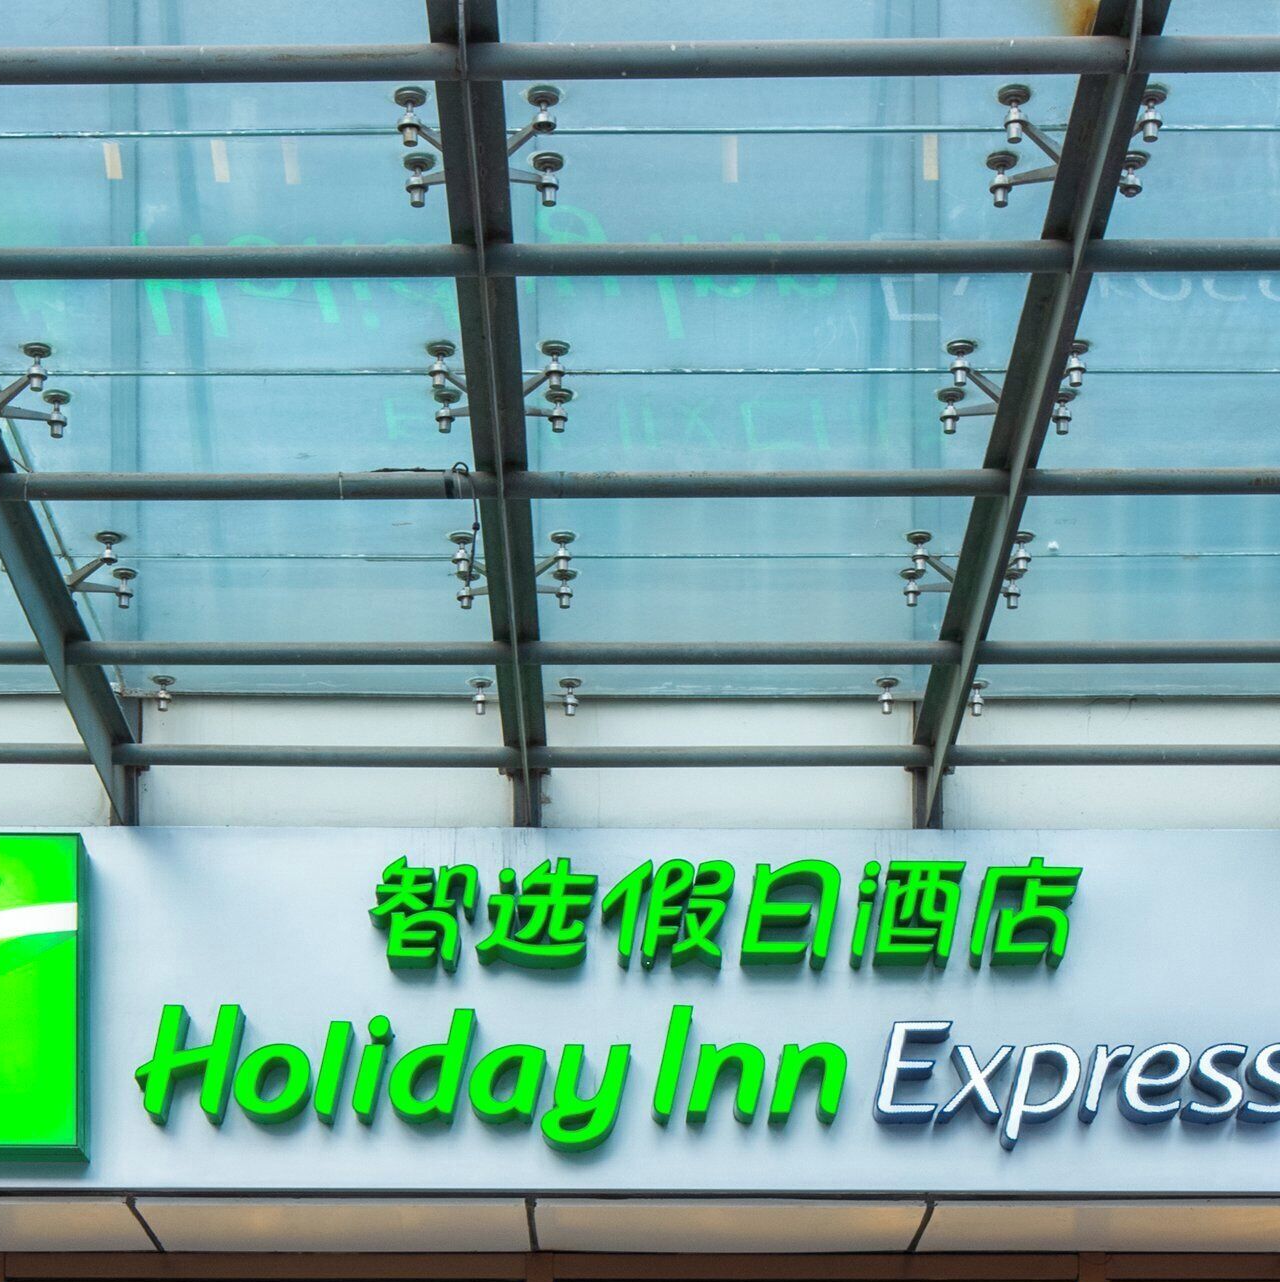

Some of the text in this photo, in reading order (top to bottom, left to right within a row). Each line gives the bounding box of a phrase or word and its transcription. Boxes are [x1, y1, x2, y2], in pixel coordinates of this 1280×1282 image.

[369, 855, 1084, 973] 智选假日酒店
[134, 1003, 631, 1152] Holiday
[652, 1004, 848, 1126] Inn
